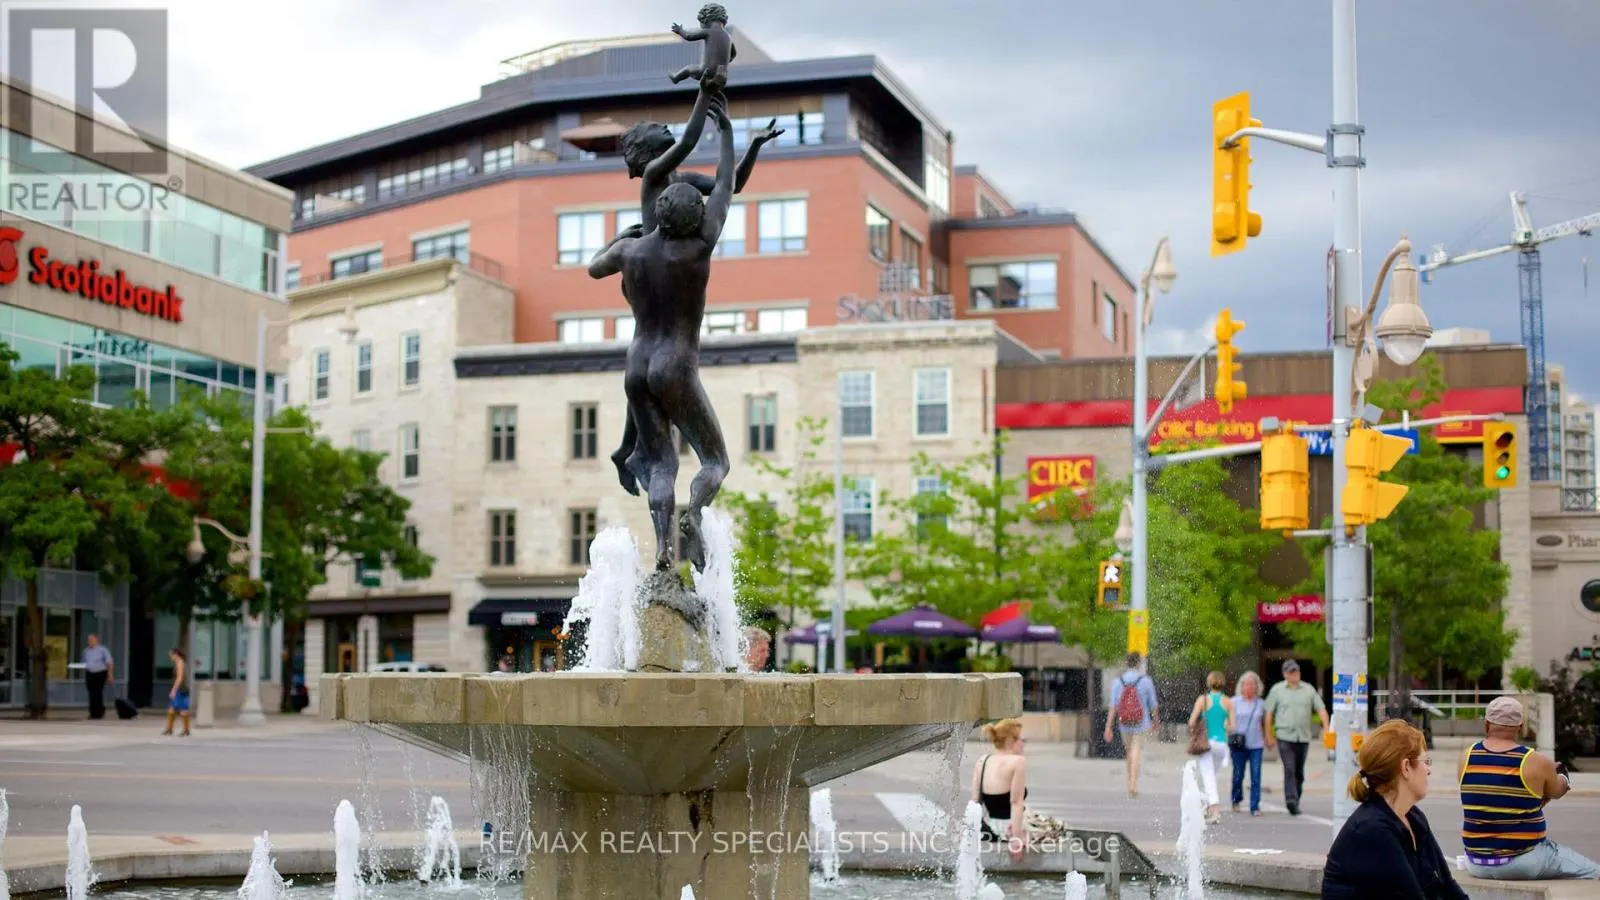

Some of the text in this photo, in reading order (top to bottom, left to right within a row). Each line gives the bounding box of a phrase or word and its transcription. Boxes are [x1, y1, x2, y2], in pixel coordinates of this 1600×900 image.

[29, 247, 184, 323] Scotiabank
[1158, 420, 1194, 438] CIBC
[1195, 419, 1255, 439] Banking
[1302, 431, 1334, 454] Wy
[1031, 459, 1092, 486] CIBC
